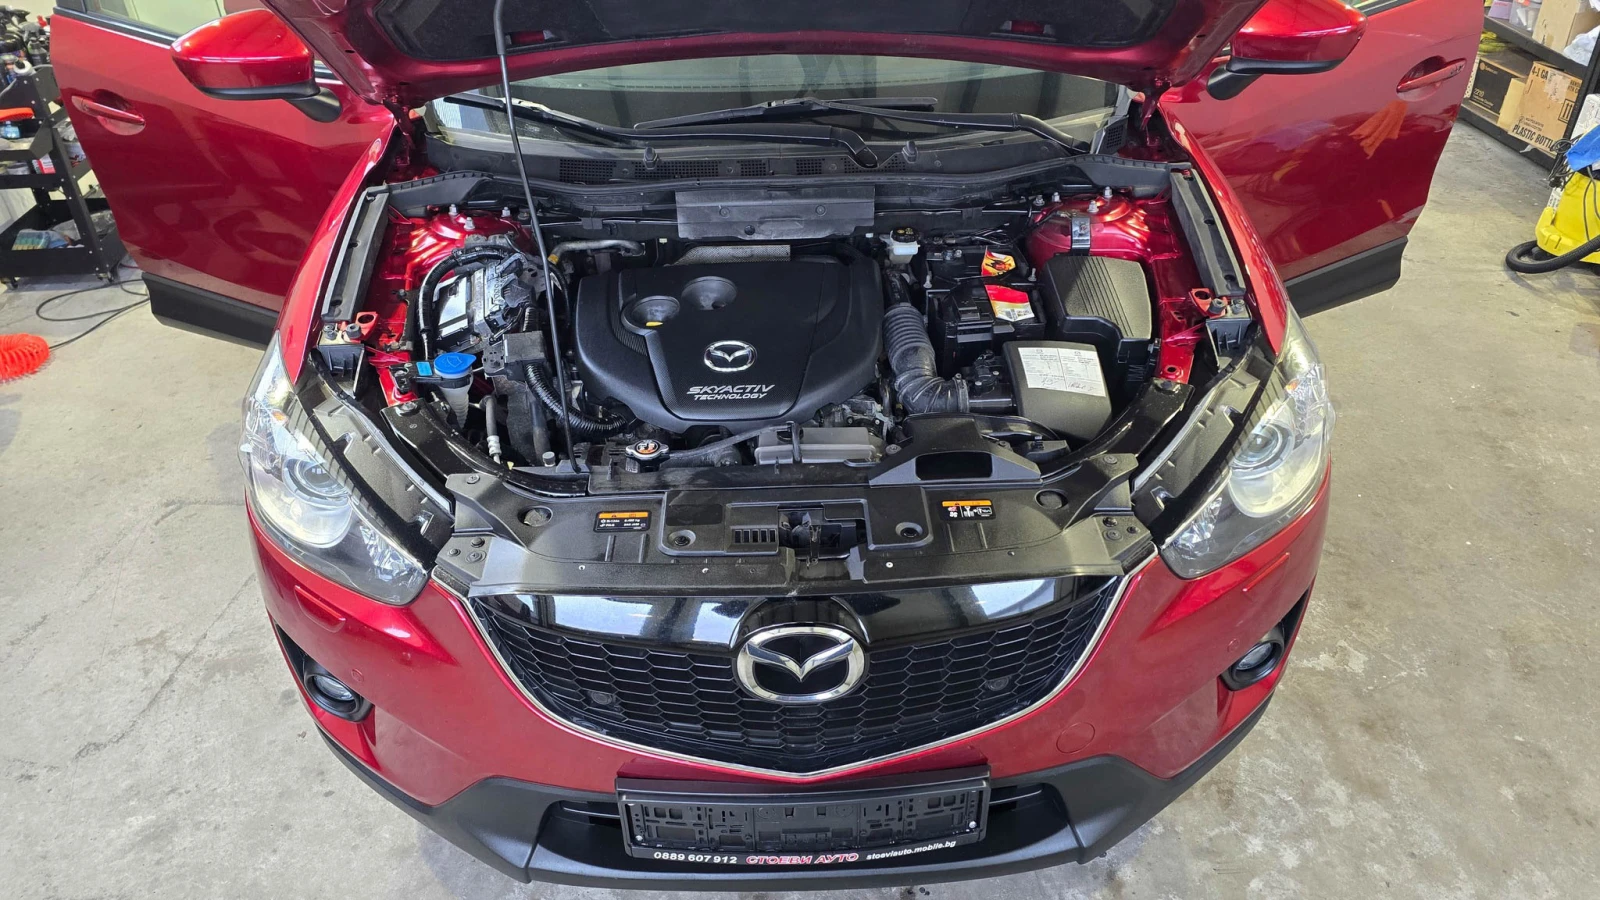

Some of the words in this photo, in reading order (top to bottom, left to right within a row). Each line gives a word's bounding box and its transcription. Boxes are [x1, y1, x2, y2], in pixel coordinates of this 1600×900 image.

[1512, 124, 1536, 141] PLASTIC
[1535, 133, 1555, 149] BOTTL
[686, 384, 775, 394] SKYACTIV
[866, 841, 956, 860] stoeviauto.mobile.bg
[653, 851, 685, 860] 0889
[687, 854, 712, 863] 607
[713, 855, 738, 864] 912
[745, 855, 813, 865] СТОЕВИ
[813, 852, 860, 864] АУТО
